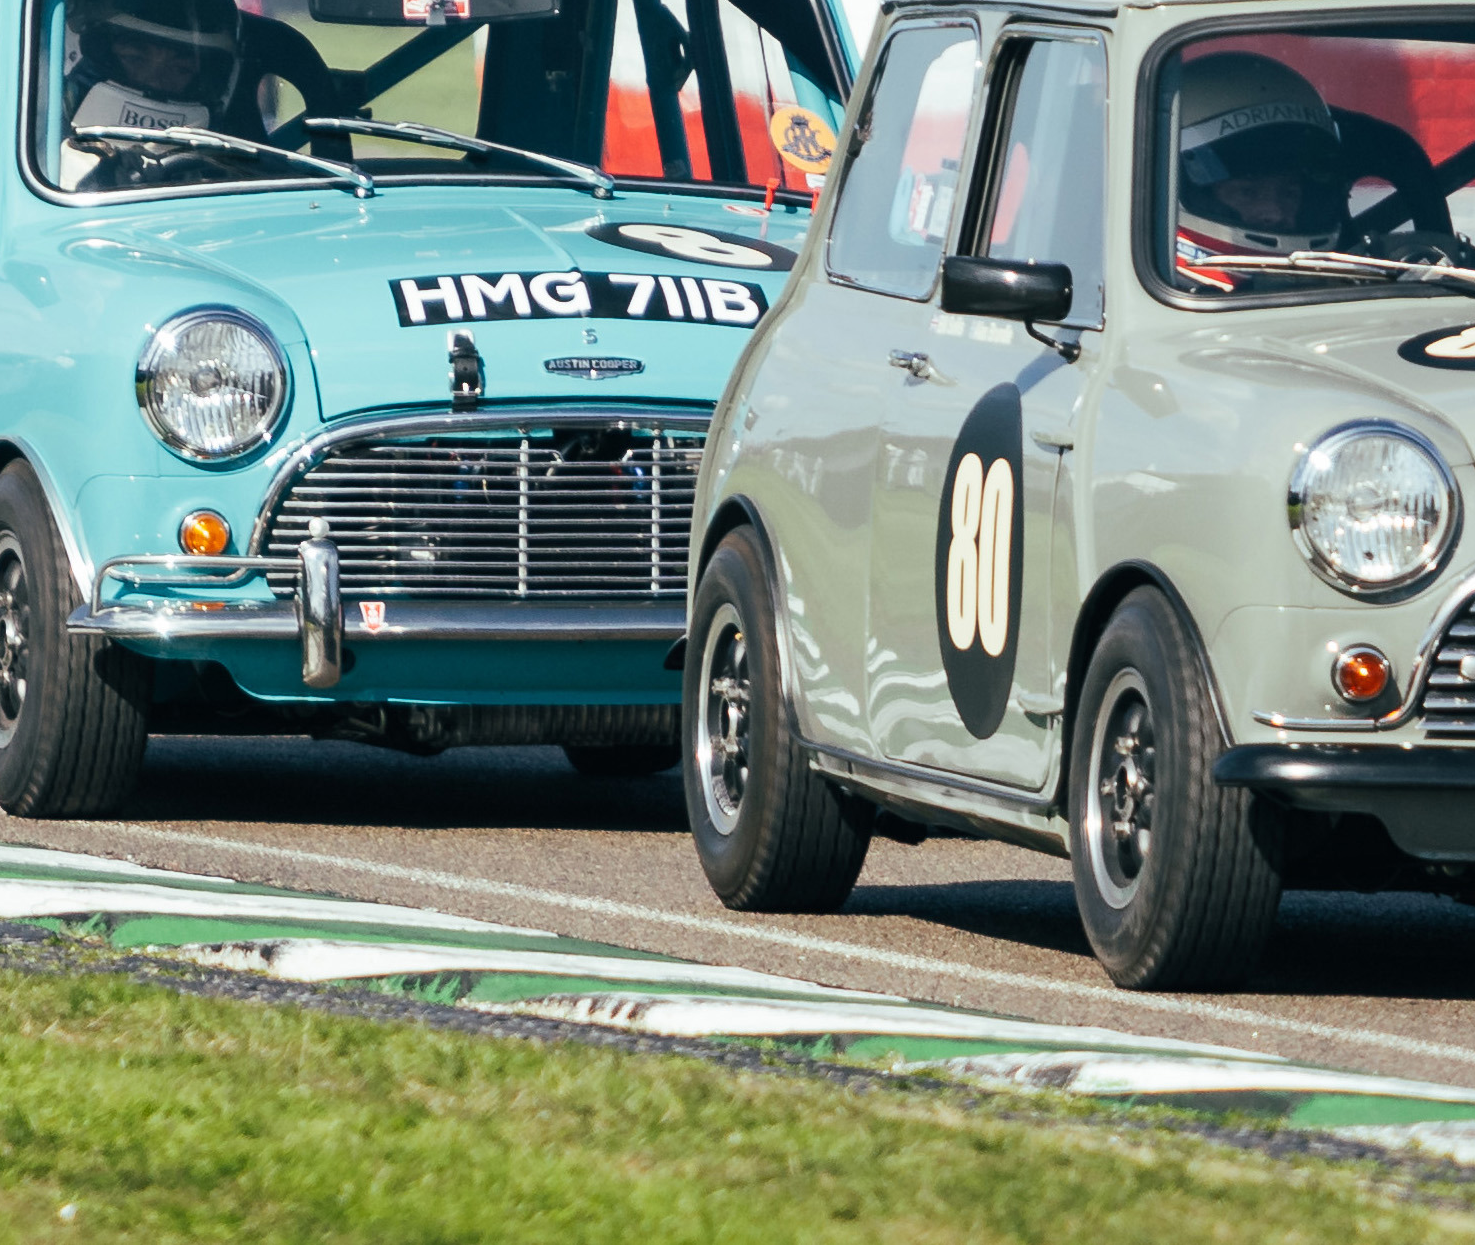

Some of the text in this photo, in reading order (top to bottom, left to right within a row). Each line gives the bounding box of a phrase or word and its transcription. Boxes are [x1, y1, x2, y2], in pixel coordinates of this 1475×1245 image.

[124, 110, 180, 130] BOSS
[1218, 105, 1304, 137] ADRIAN
[618, 223, 773, 266] 8
[399, 271, 761, 325] HMG 711B
[548, 358, 637, 369] AUSTIN COOPER
[946, 452, 1015, 657] 80
